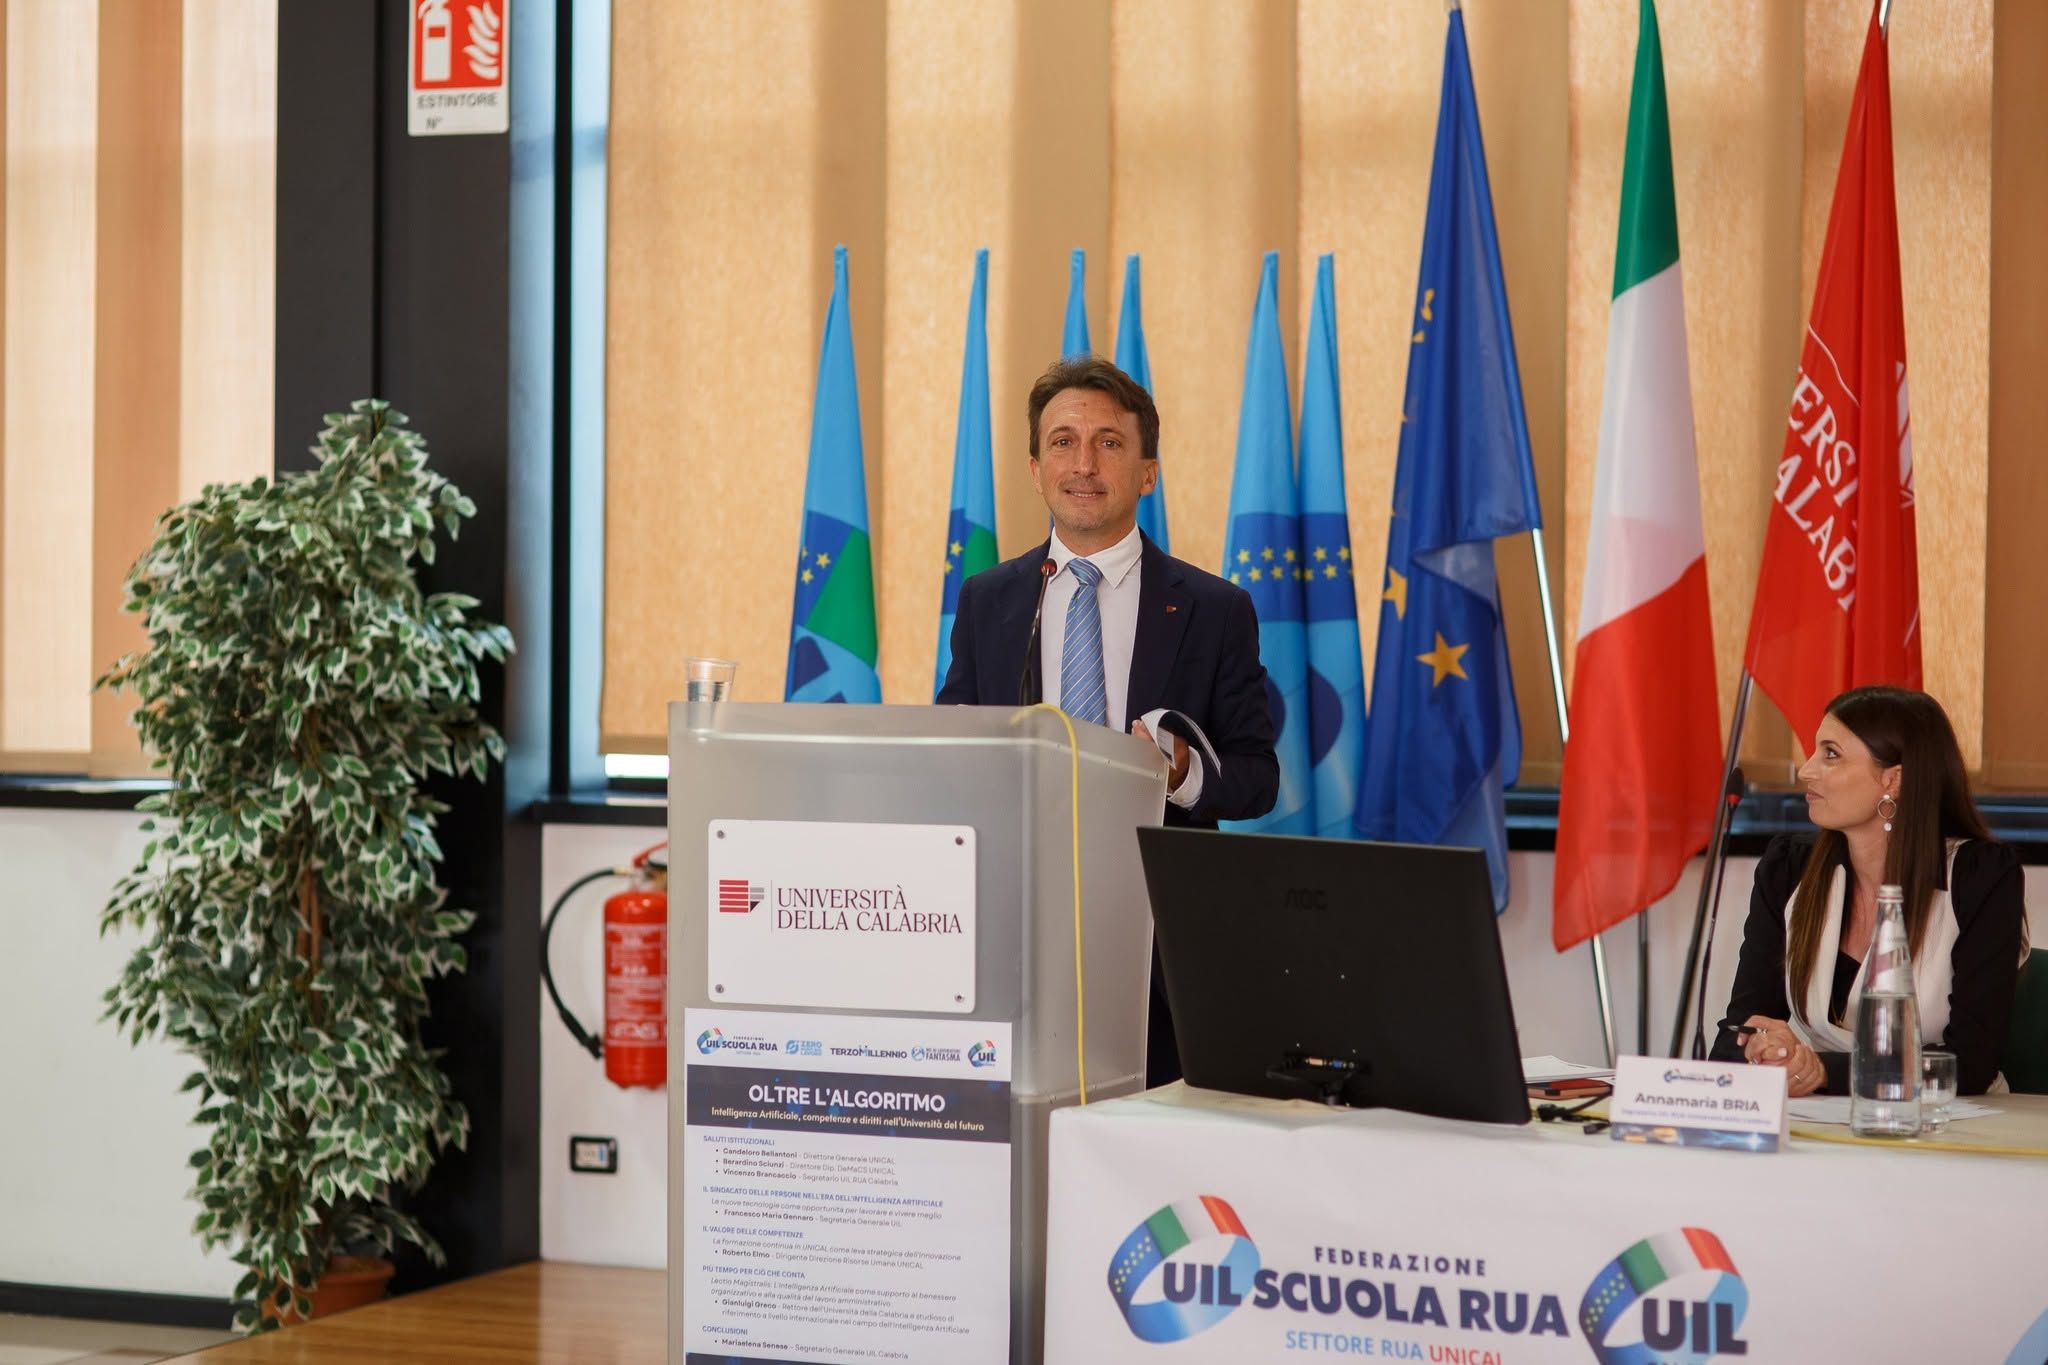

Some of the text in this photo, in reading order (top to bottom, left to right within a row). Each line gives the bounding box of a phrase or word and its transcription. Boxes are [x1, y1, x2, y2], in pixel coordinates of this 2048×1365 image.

[417, 93, 497, 109] ESTINTORE
[1788, 366, 1858, 509] ERSI
[1774, 454, 1857, 612] ALAB
[777, 884, 908, 910] UNIVERSITÀ
[777, 910, 962, 934] DELLA CALABRIA
[706, 1040, 778, 1051] UIL SCUOLA RUA
[926, 1053, 961, 1062] FANTASMA
[978, 1052, 996, 1062] UIL
[748, 1085, 945, 1112] OLTRE L'ALGORITMO
[1635, 1093, 1760, 1111] Annamaria BRIA
[711, 1107, 984, 1131] Intelligenza Artificiale, competenze e diritti nell'Università del futuro
[704, 1135, 775, 1146] SALUTI ISTITUZIONALI
[710, 1226, 735, 1234] VALORE
[736, 1227, 757, 1235] DELLE
[758, 1229, 804, 1238] COMPETENZE
[703, 1263, 806, 1279] PIÙ TEMPO PER CIÒ CHE CONTA
[1314, 1245, 1487, 1277] FEDERAZIONE
[1163, 1262, 1570, 1338] UIL SCUOLA RUA
[702, 1325, 748, 1335] CONCLUSIONI
[1642, 1298, 1747, 1355] UIL
[1285, 1330, 1374, 1355] SETTORE
[1381, 1338, 1424, 1361] RUA
